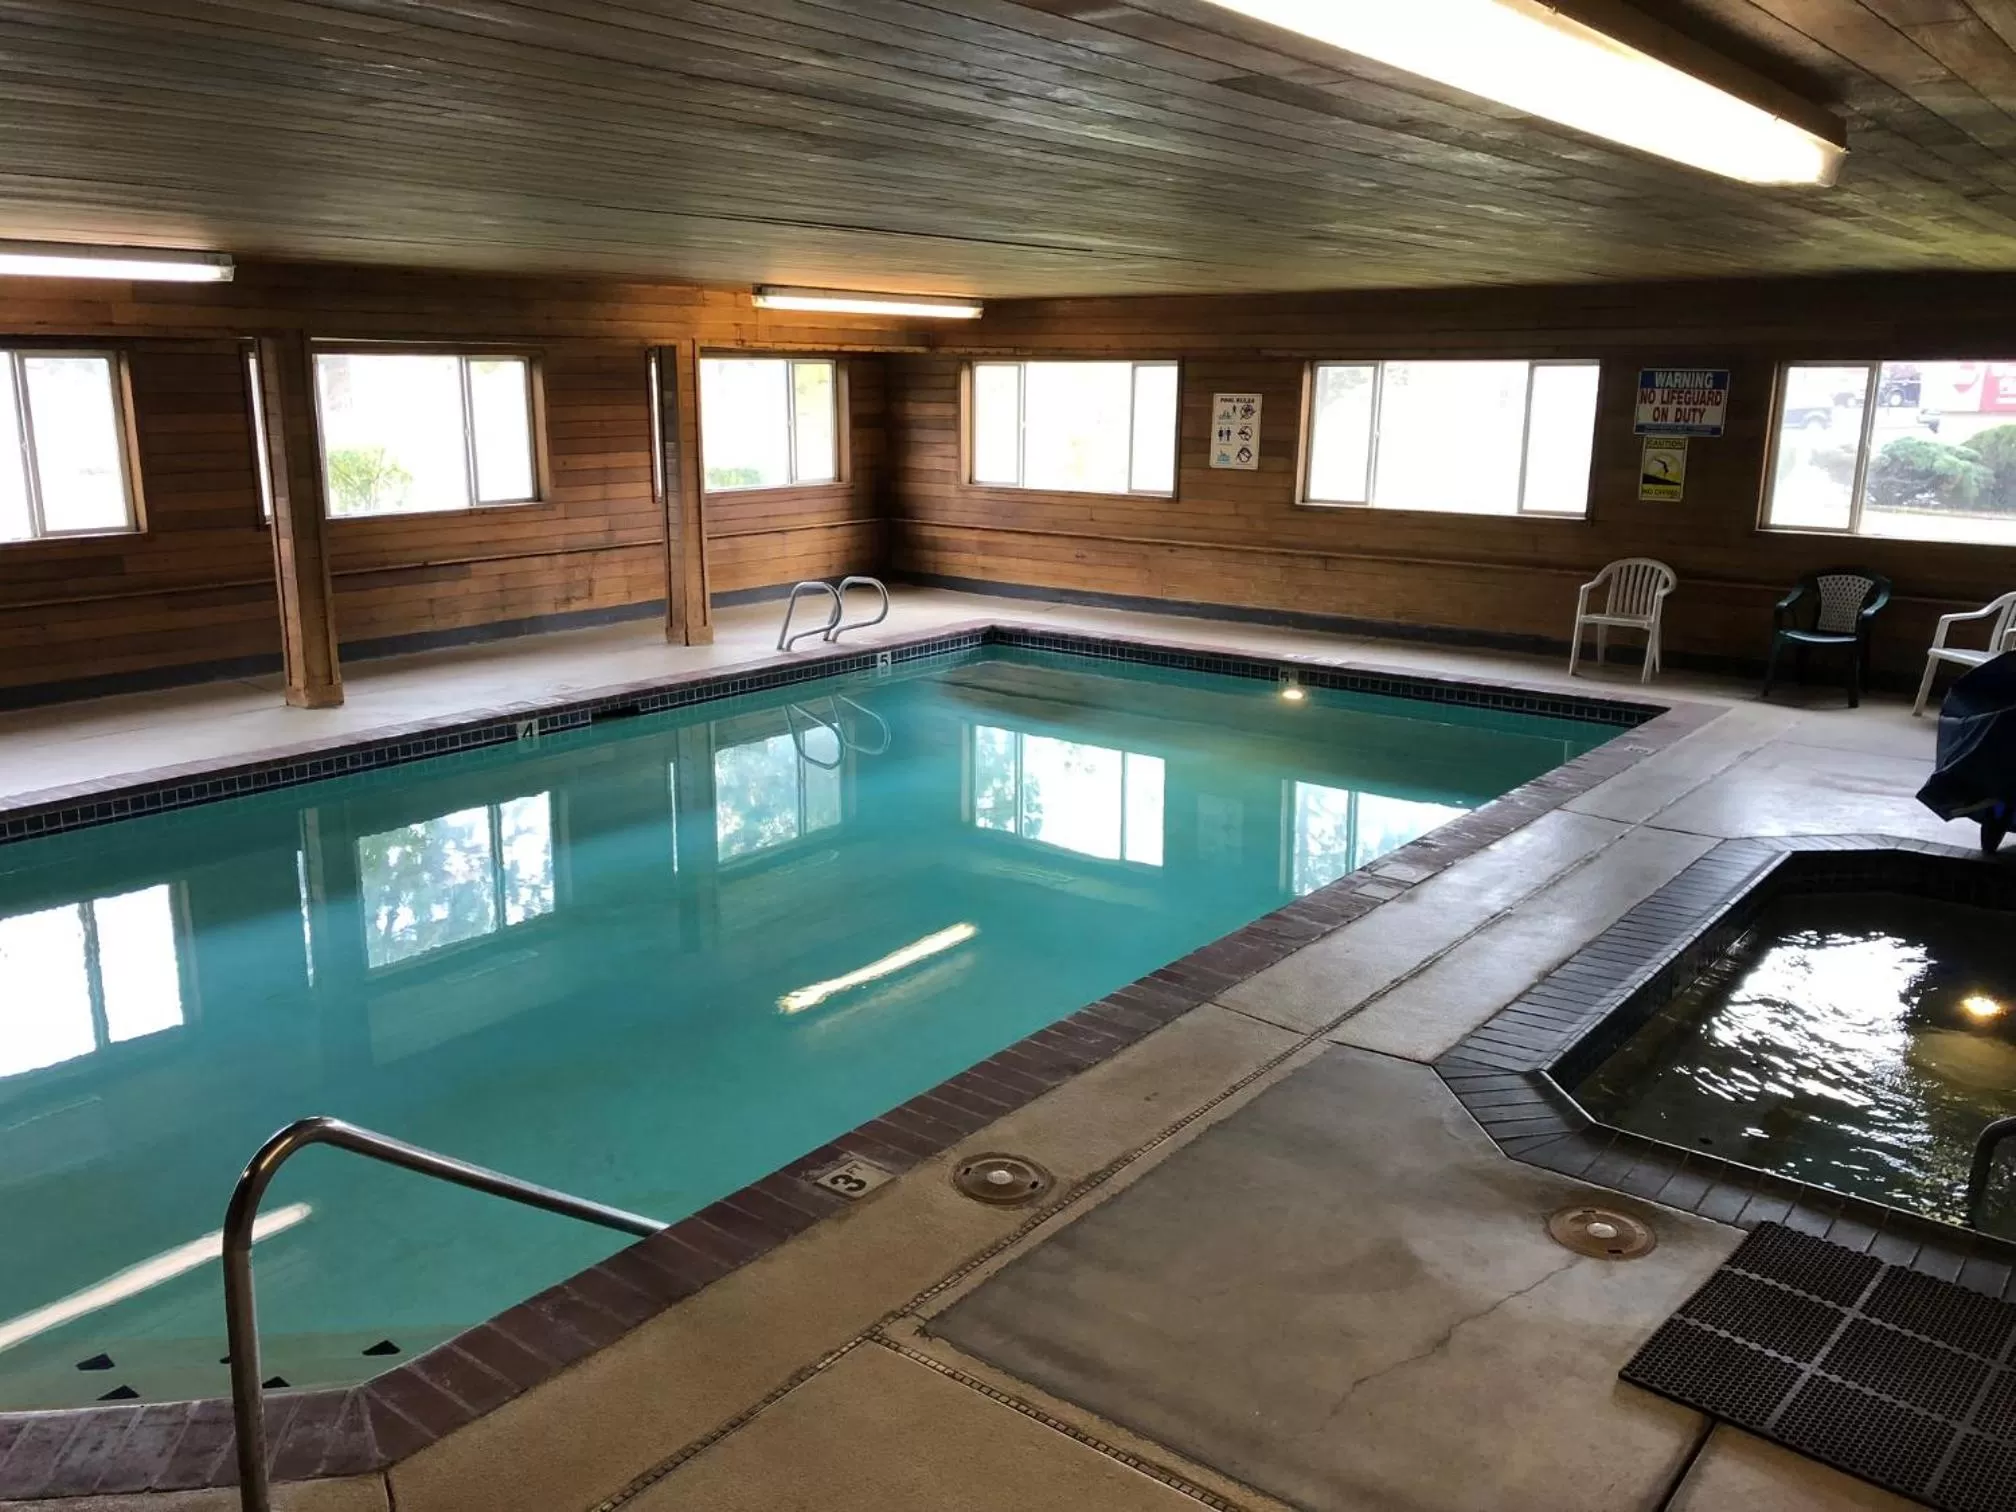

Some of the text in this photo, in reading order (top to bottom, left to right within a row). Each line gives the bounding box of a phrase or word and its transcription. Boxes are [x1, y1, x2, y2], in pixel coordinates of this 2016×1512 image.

[1655, 371, 1713, 388] WARNING
[1640, 389, 1722, 406] NO LIFEGUARD
[1652, 406, 1706, 423] ON DUTY
[881, 653, 889, 667] 5
[522, 721, 533, 738] 4
[830, 1174, 867, 1192] 3
